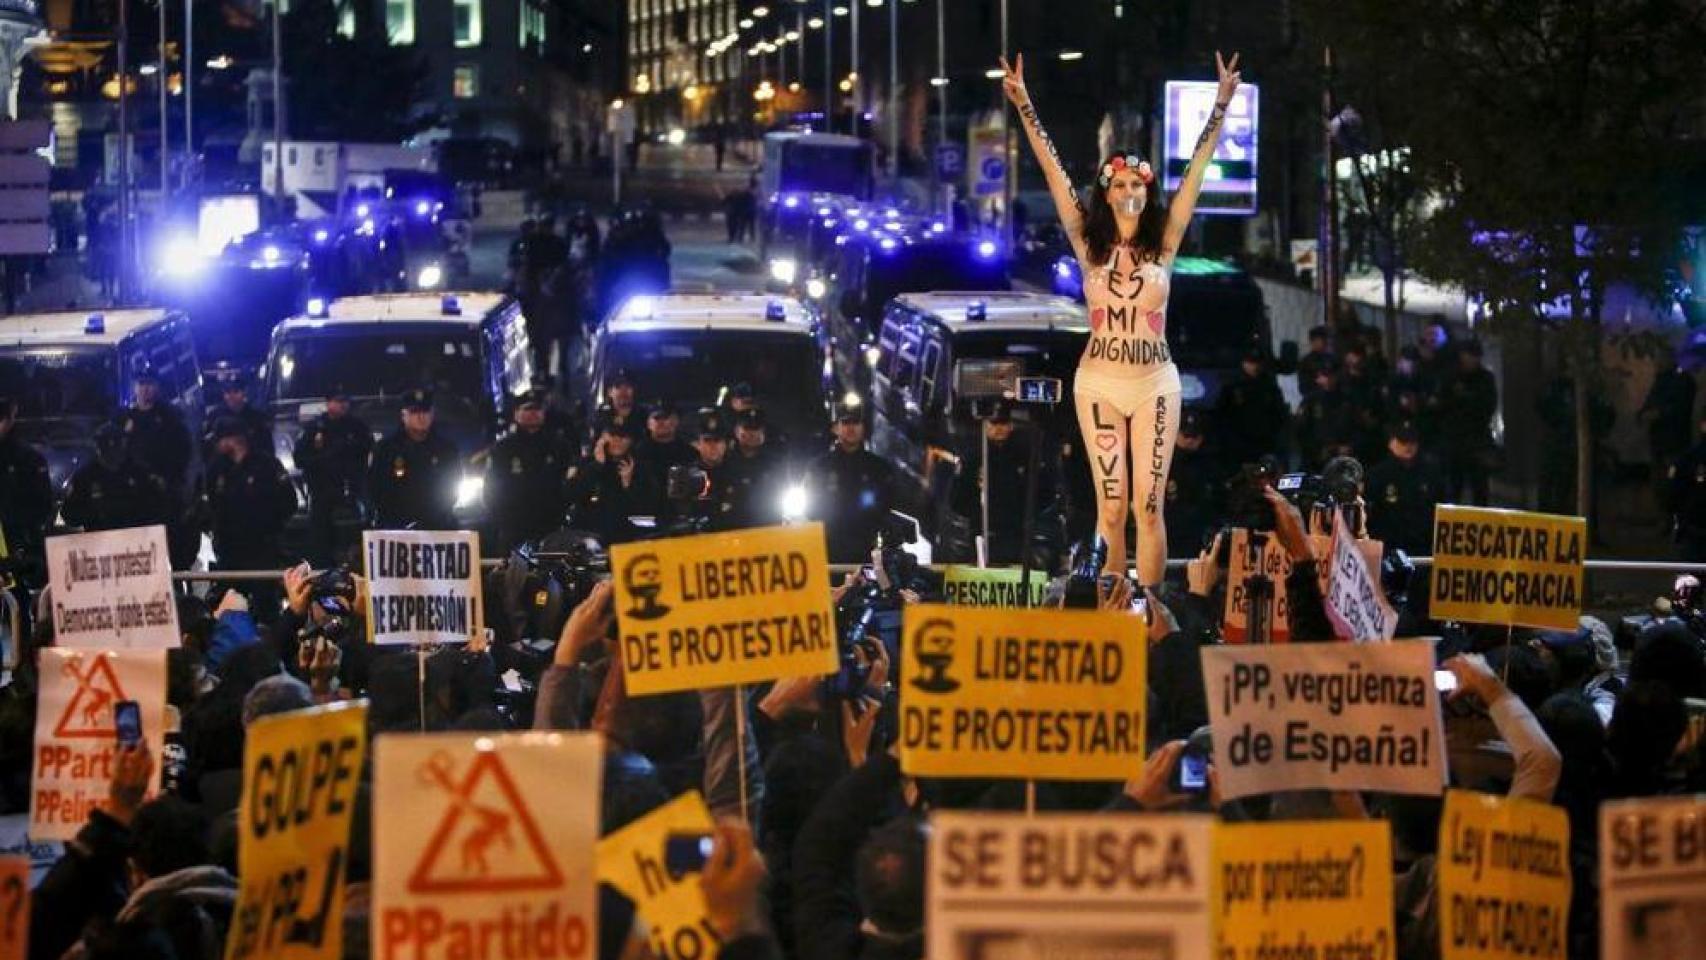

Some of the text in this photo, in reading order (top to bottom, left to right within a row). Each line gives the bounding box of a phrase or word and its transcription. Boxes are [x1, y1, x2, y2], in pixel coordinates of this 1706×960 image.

[1108, 268, 1144, 300] ES
[1107, 304, 1137, 335] MI
[1089, 337, 1171, 366] DIGNIDAD
[1435, 520, 1580, 564] RESCATAR LA
[678, 551, 808, 602] LIBERTAD
[625, 610, 831, 672] DE PROTESTAR!
[975, 635, 1123, 685] LIBERTAD
[1224, 662, 1427, 716] ¡PP, vergüenza
[905, 706, 1142, 755] DE PROTESTAR!
[1229, 721, 1430, 772] de España!
[252, 737, 357, 838] GOLPE
[942, 830, 1194, 889] SE BUSCA
[1612, 814, 1659, 868] SE
[1223, 843, 1365, 917] por protestar?
[383, 903, 587, 960] PPartido
